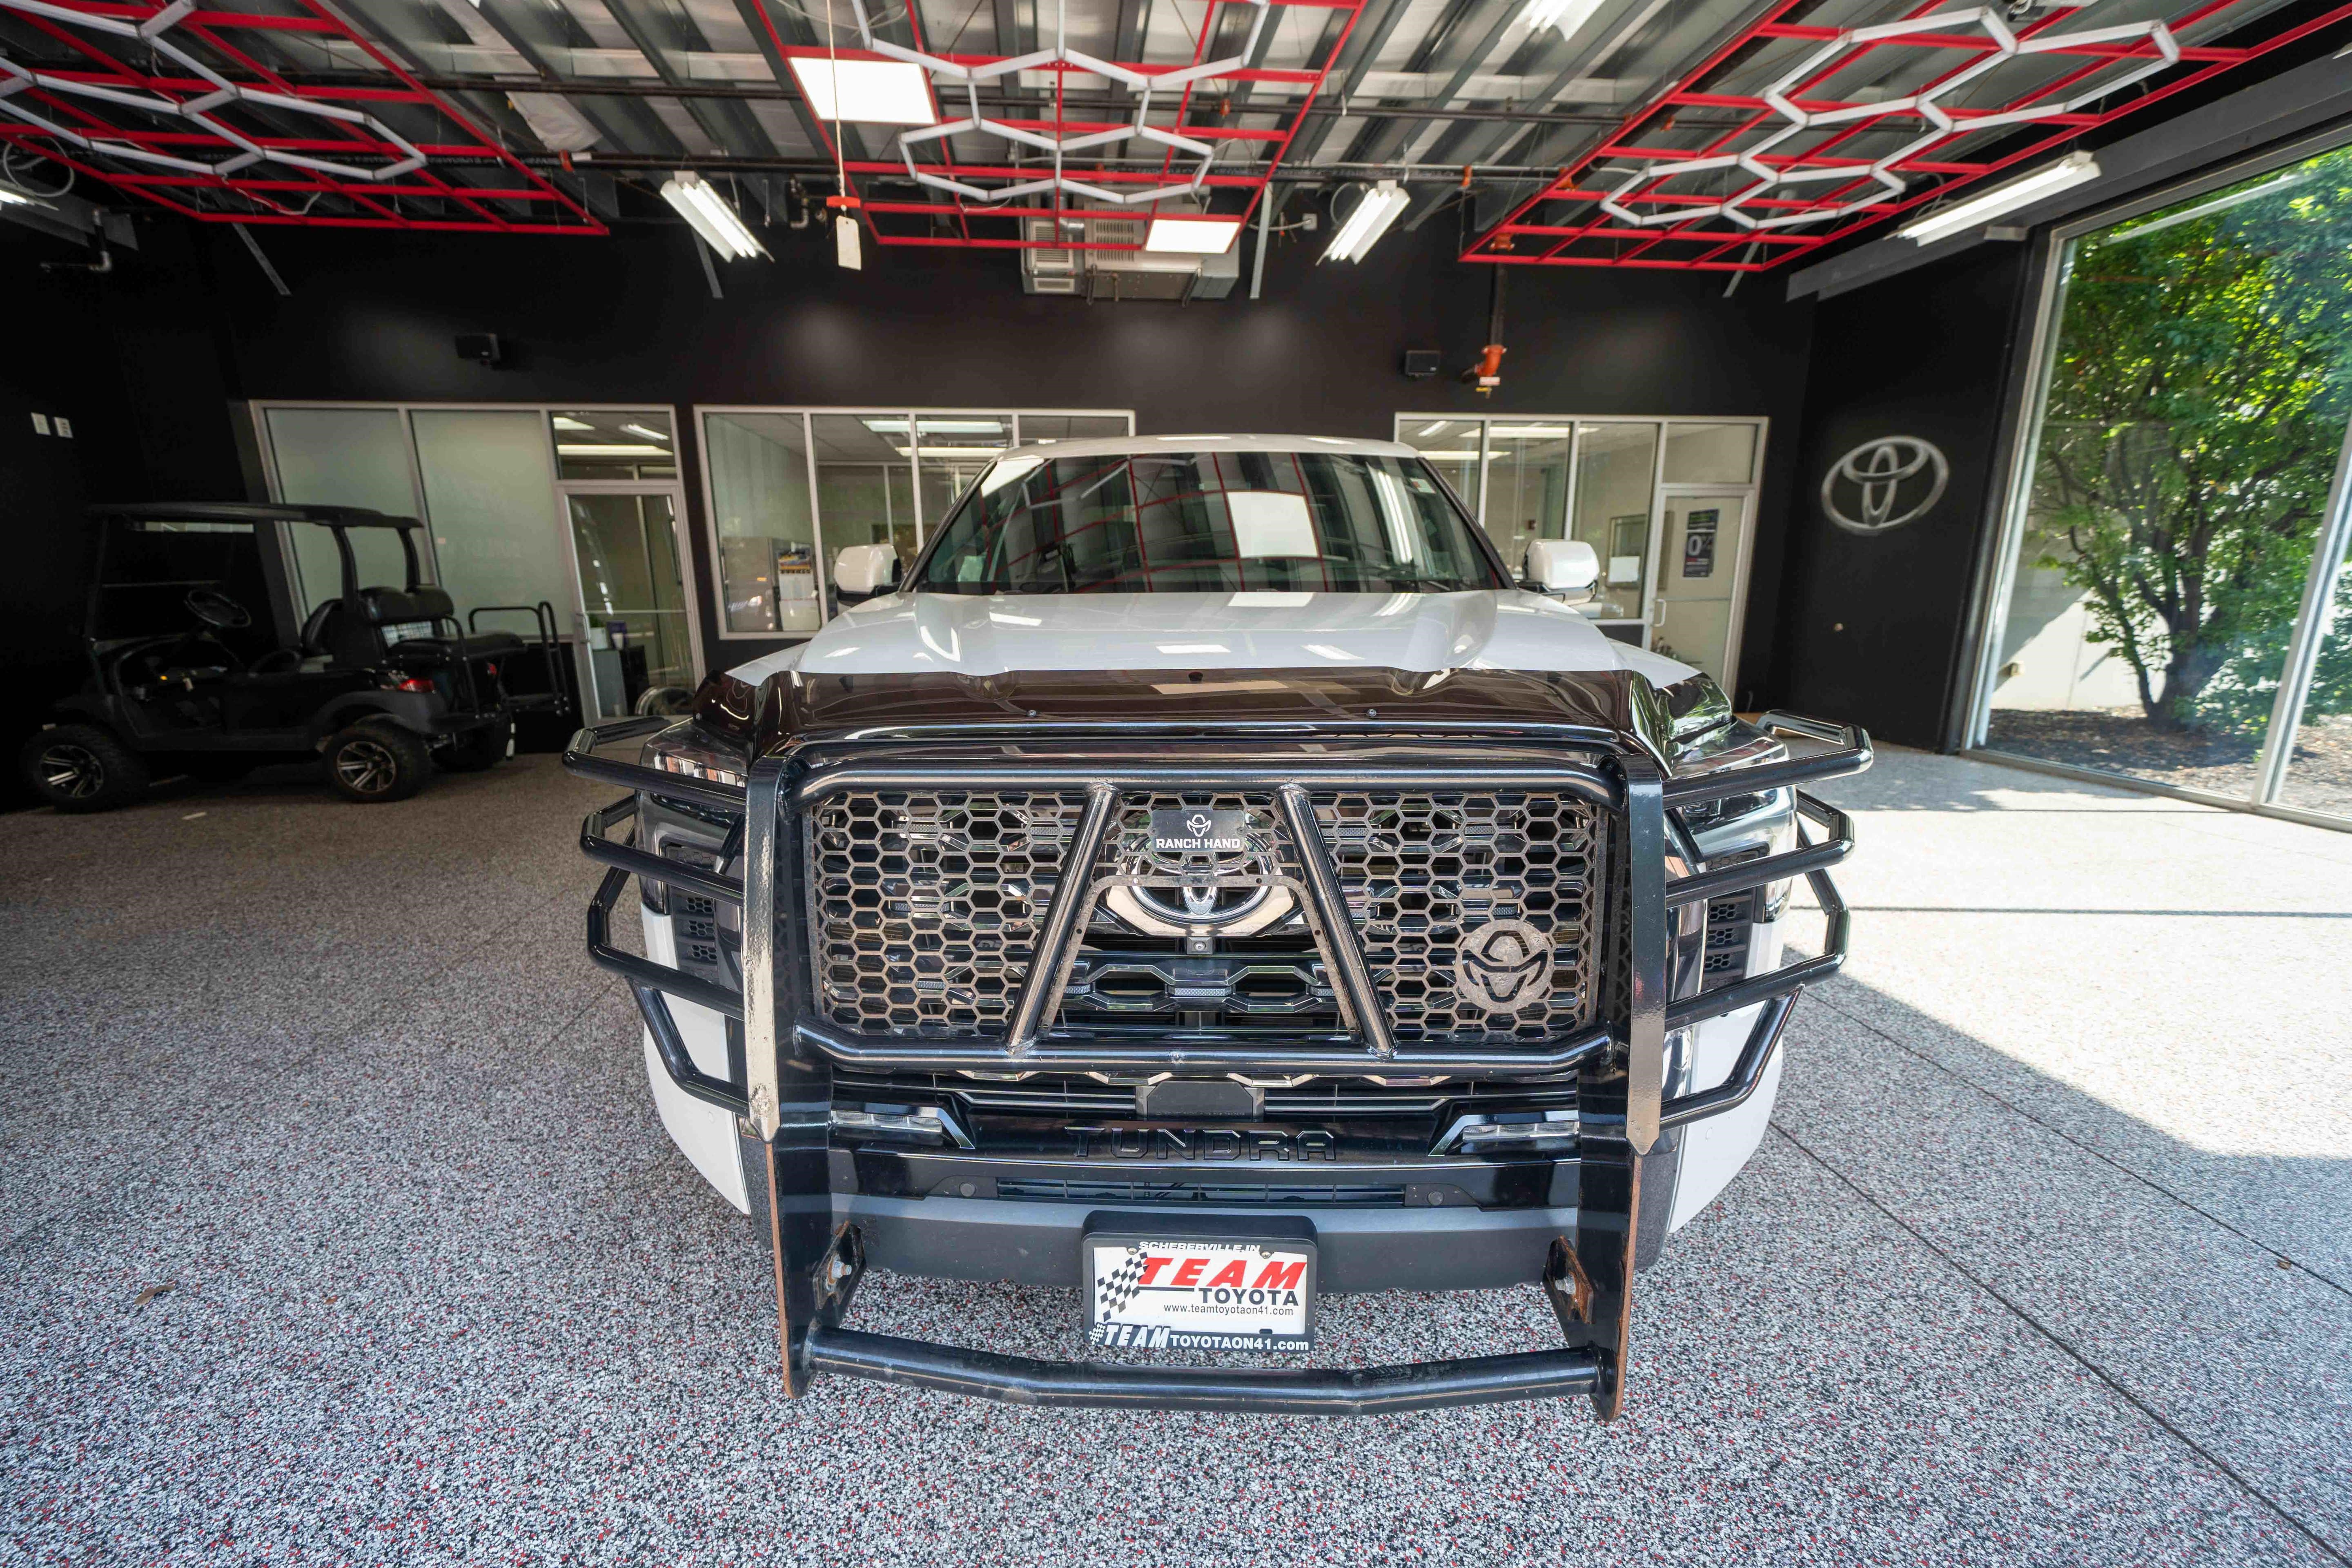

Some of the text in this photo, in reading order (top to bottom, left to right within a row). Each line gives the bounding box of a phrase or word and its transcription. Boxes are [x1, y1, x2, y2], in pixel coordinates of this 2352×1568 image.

[1156, 838, 1240, 849] RANCH HAND
[1064, 1127, 1336, 1161] TUNDRA
[1138, 1257, 1306, 1289] TEAM
[1199, 1288, 1299, 1305] TOYOTA
[1164, 1304, 1294, 1316] www.teamtoyotaon41.com
[1104, 1324, 1309, 1350] TEAM TOYOTAON41.com
